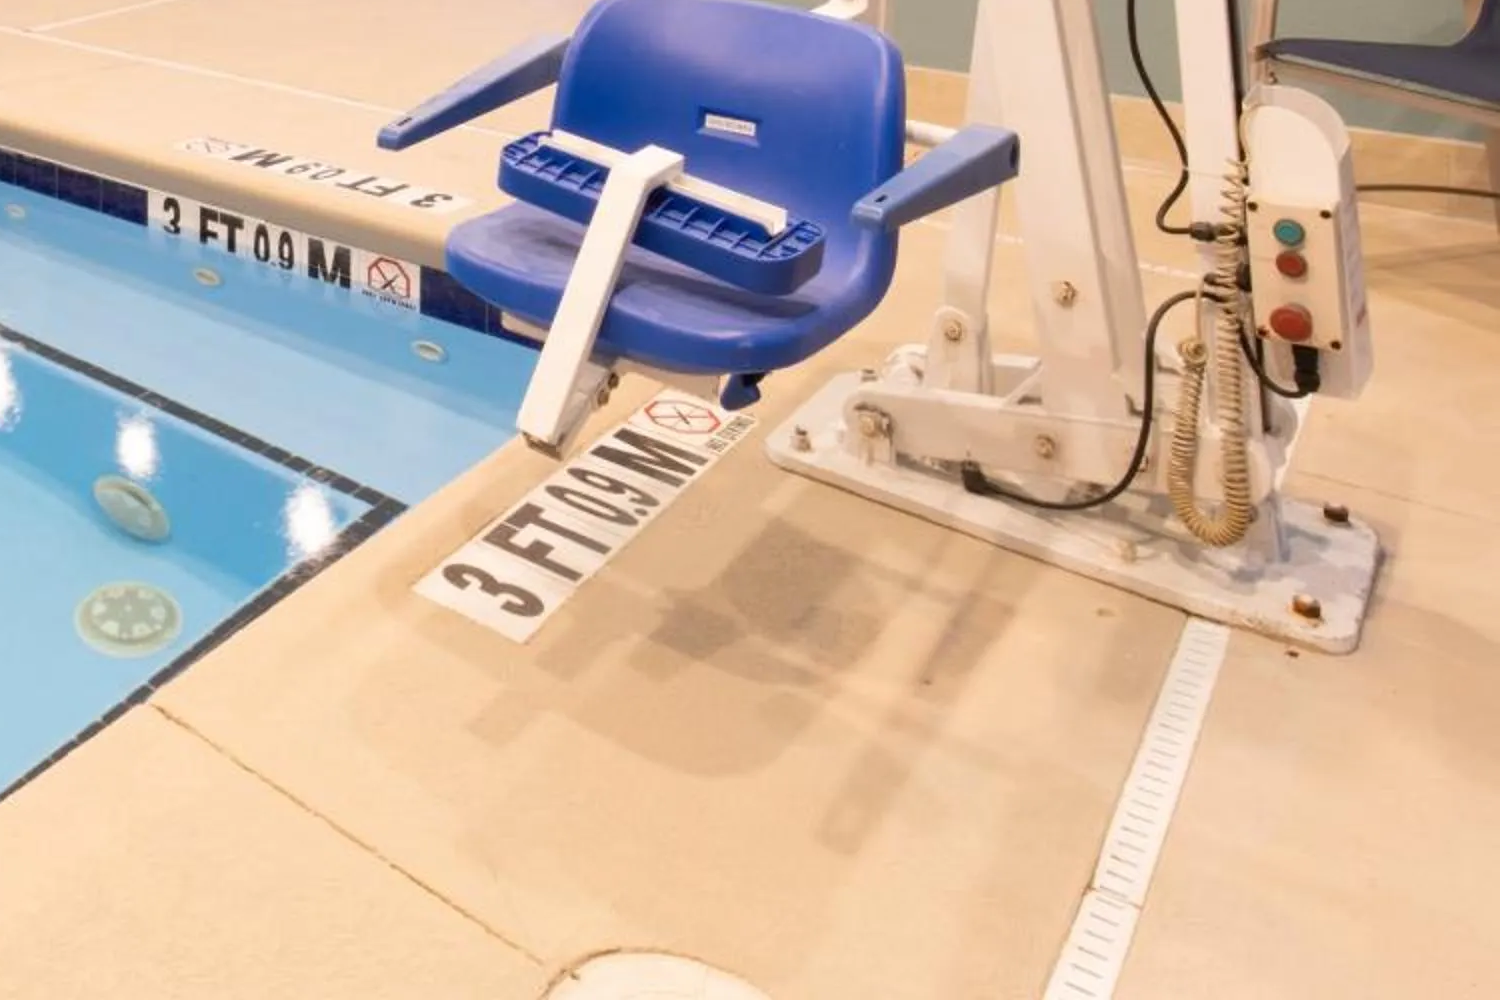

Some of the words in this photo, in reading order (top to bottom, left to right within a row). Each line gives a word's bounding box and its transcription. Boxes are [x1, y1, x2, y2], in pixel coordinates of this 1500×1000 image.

[227, 149, 293, 168] M
[335, 176, 410, 197] FT
[410, 193, 453, 208] 3
[164, 197, 181, 235] 3
[200, 207, 243, 253] FT
[308, 238, 351, 290] M
[588, 427, 709, 488] M
[544, 467, 660, 527] 0.9
[481, 502, 613, 583] FT
[442, 563, 544, 618] 3
